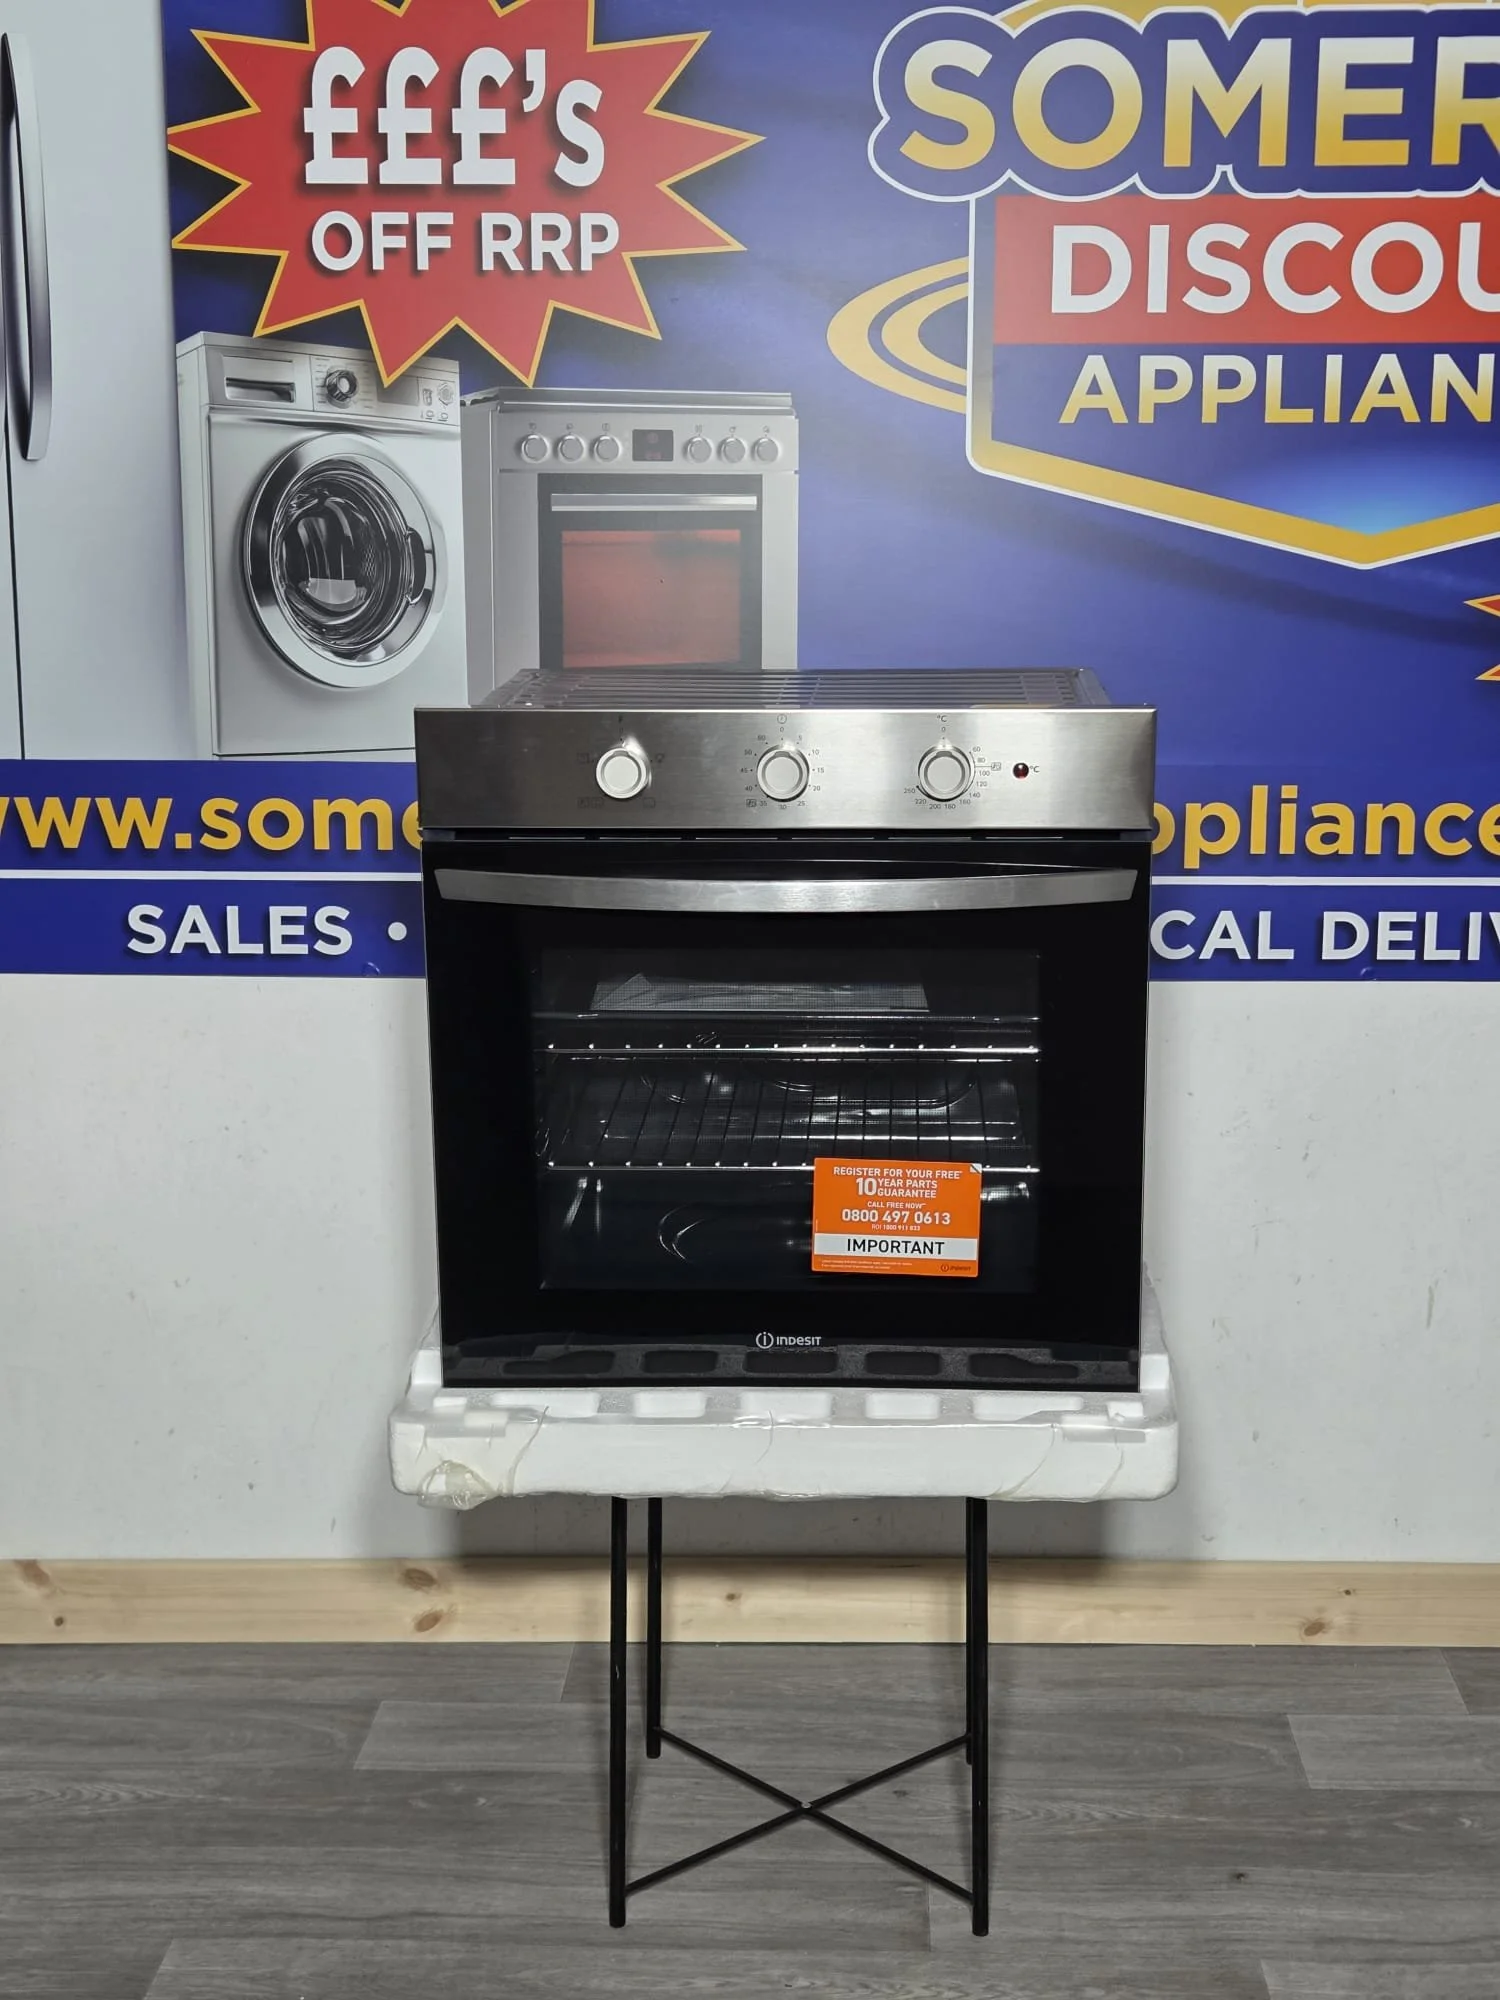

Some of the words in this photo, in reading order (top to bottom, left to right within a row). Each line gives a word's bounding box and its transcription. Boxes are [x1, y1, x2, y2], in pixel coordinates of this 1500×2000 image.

[900, 36, 1500, 170] SOMER
[311, 210, 454, 271] OFF
[480, 212, 619, 271] RRP
[1058, 353, 1495, 424] APPLIAN
[0, 796, 423, 851] ww.som
[127, 904, 353, 956] SALES
[1321, 911, 1500, 961] DELI
[833, 1166, 881, 1177] REGISTER
[883, 1168, 903, 1178] FOR
[905, 1169, 933, 1178] YOUR
[856, 1177, 877, 1196] 10
[877, 1178, 904, 1188] YEAR
[905, 1179, 938, 1189] PARTS
[877, 1187, 937, 1199] GUARANTEE
[886, 1201, 904, 1209] FREE
[842, 1208, 879, 1222] 0800
[882, 1210, 910, 1223] 497
[914, 1211, 951, 1225] 0613
[846, 1238, 945, 1255] IMPORTANT
